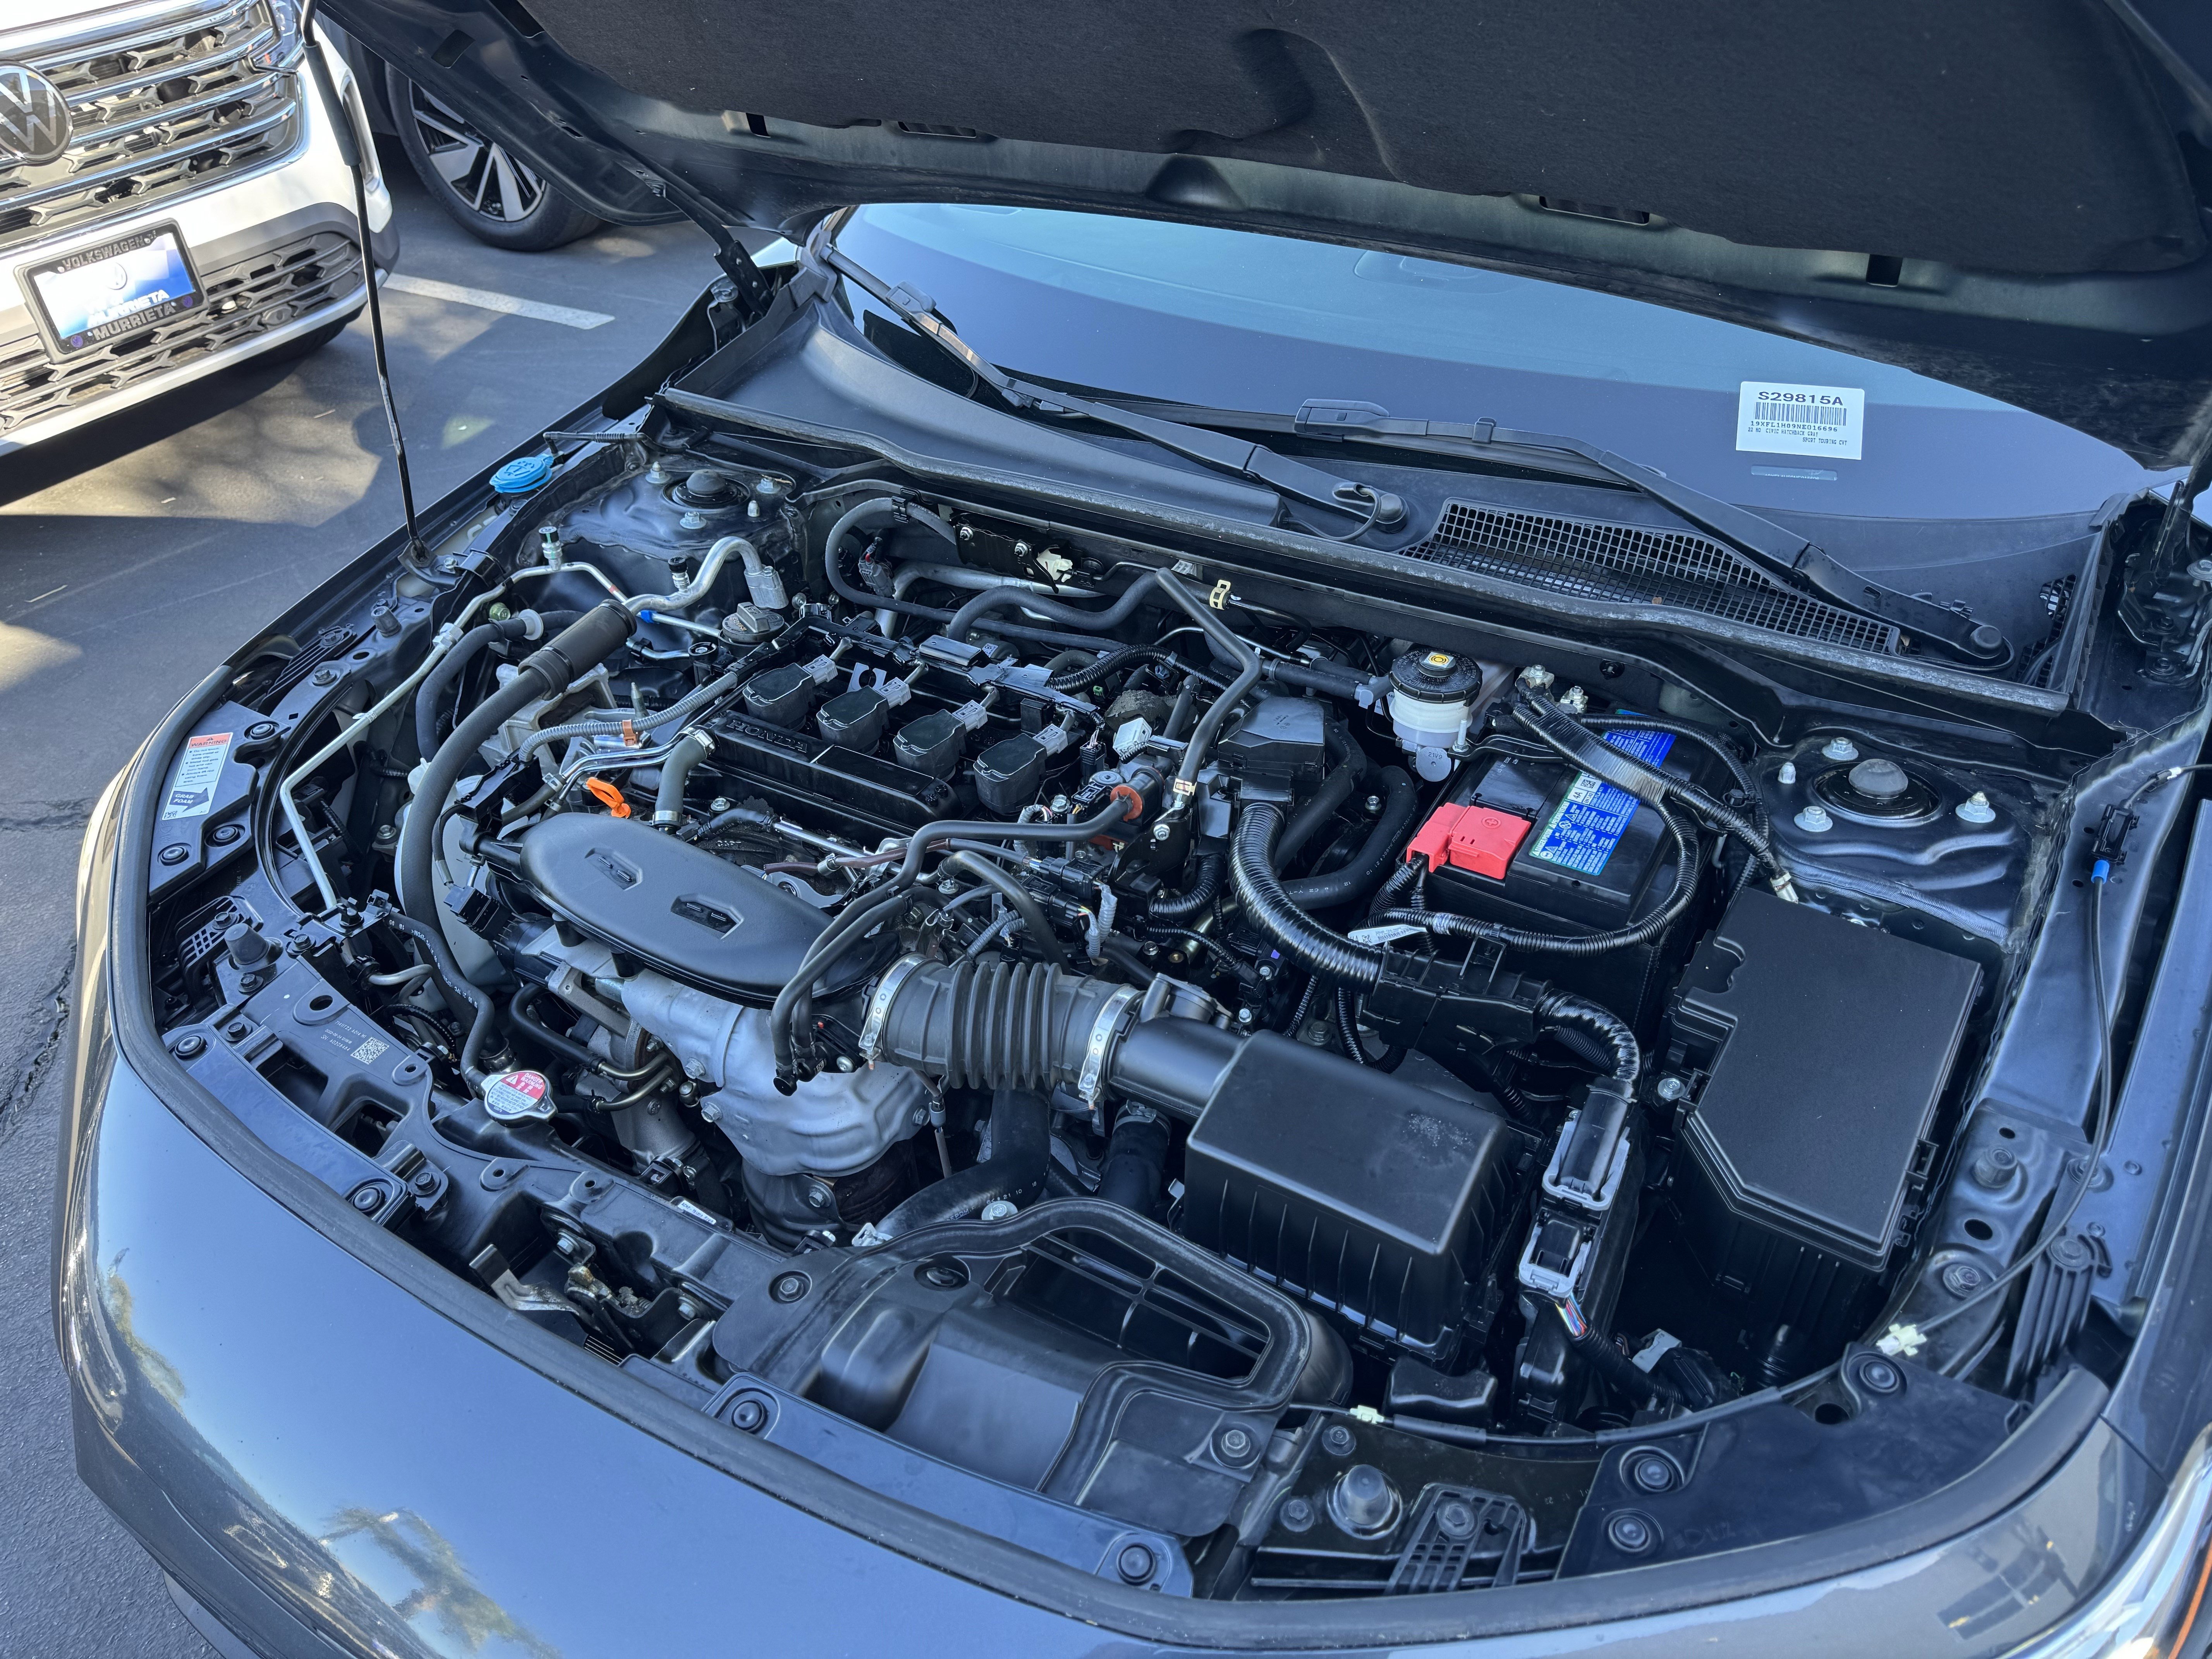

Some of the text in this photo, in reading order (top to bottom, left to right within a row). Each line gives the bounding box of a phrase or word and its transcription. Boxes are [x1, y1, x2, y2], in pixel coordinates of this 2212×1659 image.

[62, 237, 145, 270] VOLKSWAGEN
[93, 302, 176, 341] MURRIETA
[1758, 392, 1843, 406] S29815A
[1751, 421, 1838, 432] 19XFL1H09NE016696
[726, 720, 808, 753] HONDA
[520, 1076, 543, 1090] WARNING
[524, 1072, 544, 1084] DANGER
